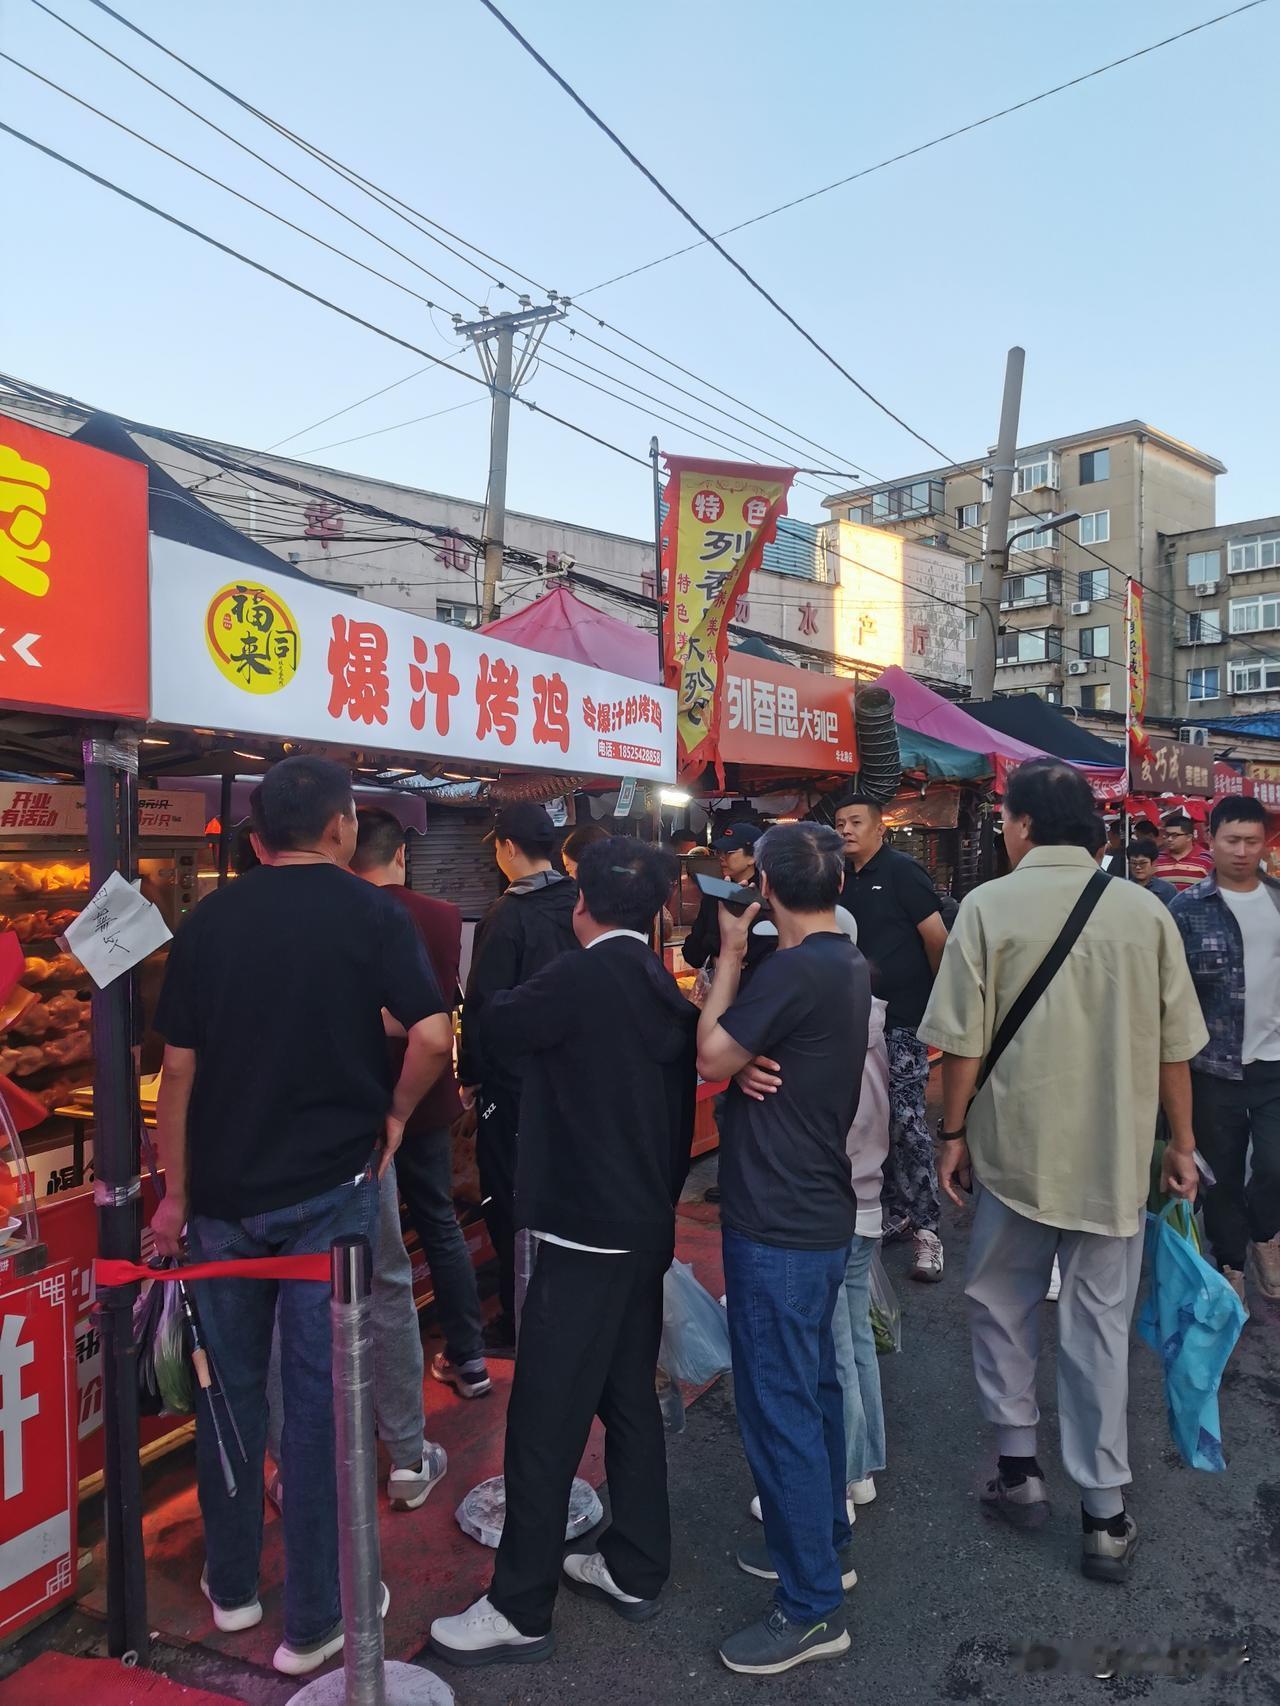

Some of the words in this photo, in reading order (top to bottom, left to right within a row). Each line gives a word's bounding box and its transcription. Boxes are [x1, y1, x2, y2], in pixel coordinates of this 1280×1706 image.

[695, 495, 766, 525] 特色
[327, 613, 570, 753] 爆汁烤鸡
[726, 674, 799, 738] 列香思
[799, 707, 839, 743] 大列巴
[12, 791, 52, 809] 开业
[1, 809, 58, 827] 有活动
